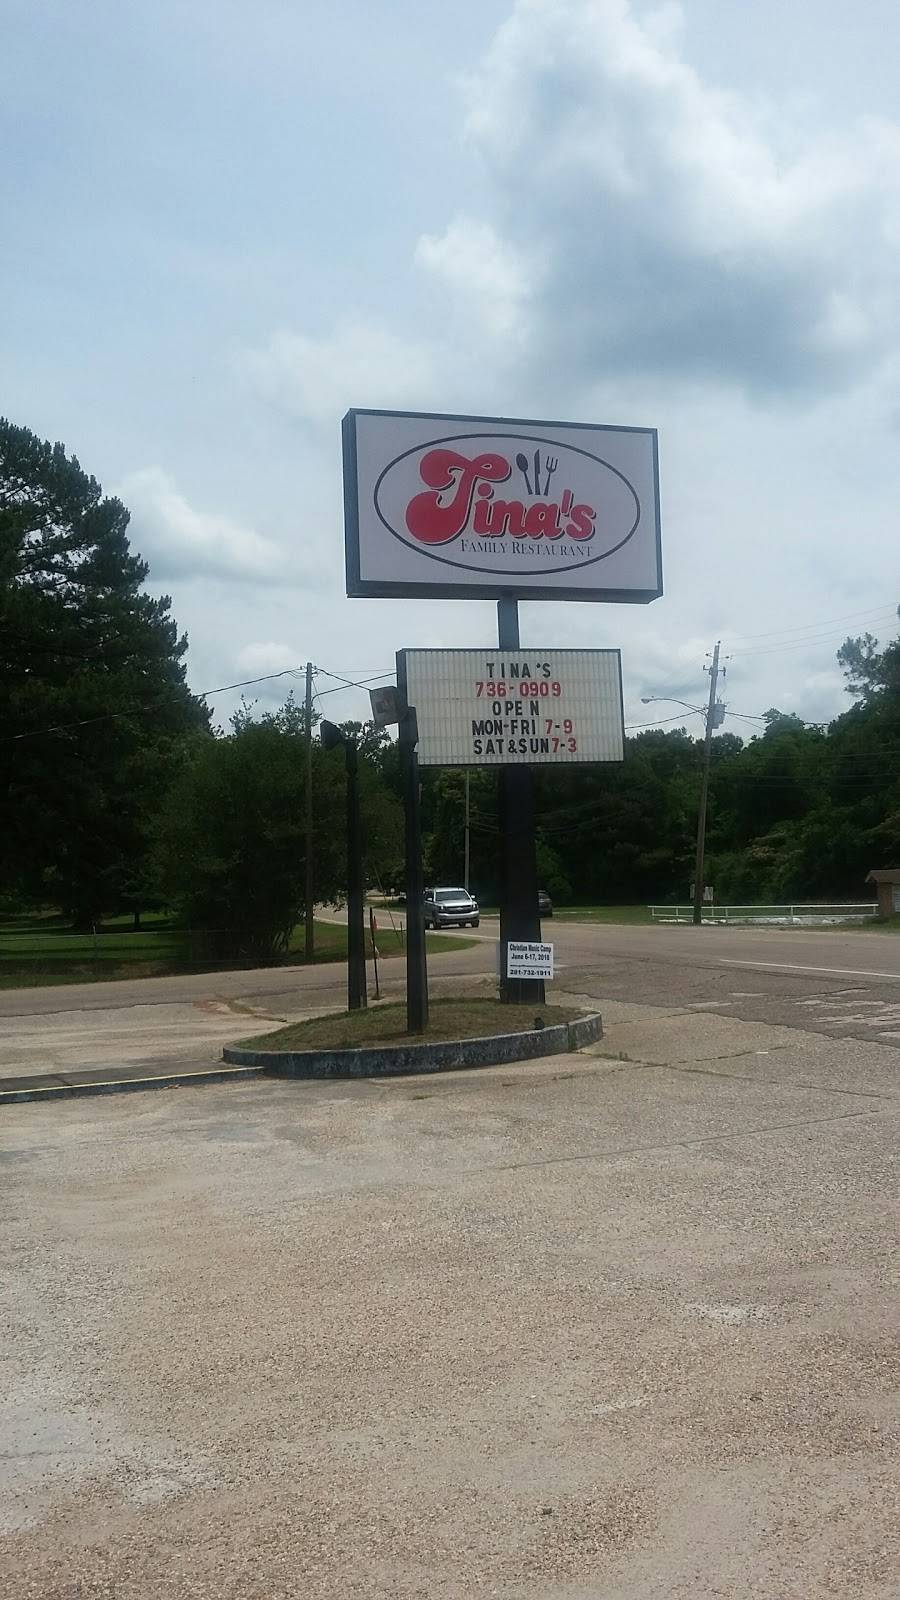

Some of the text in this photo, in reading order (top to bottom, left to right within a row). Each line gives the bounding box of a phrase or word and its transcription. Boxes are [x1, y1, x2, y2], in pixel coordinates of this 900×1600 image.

[405, 448, 596, 546] Tina's
[461, 539, 593, 557] FAMILY RESTAURANT
[486, 663, 551, 678] TINA'S
[475, 681, 562, 697] 736-0909
[492, 701, 540, 716] OPEN
[472, 719, 573, 735] MON-FRI 7-9
